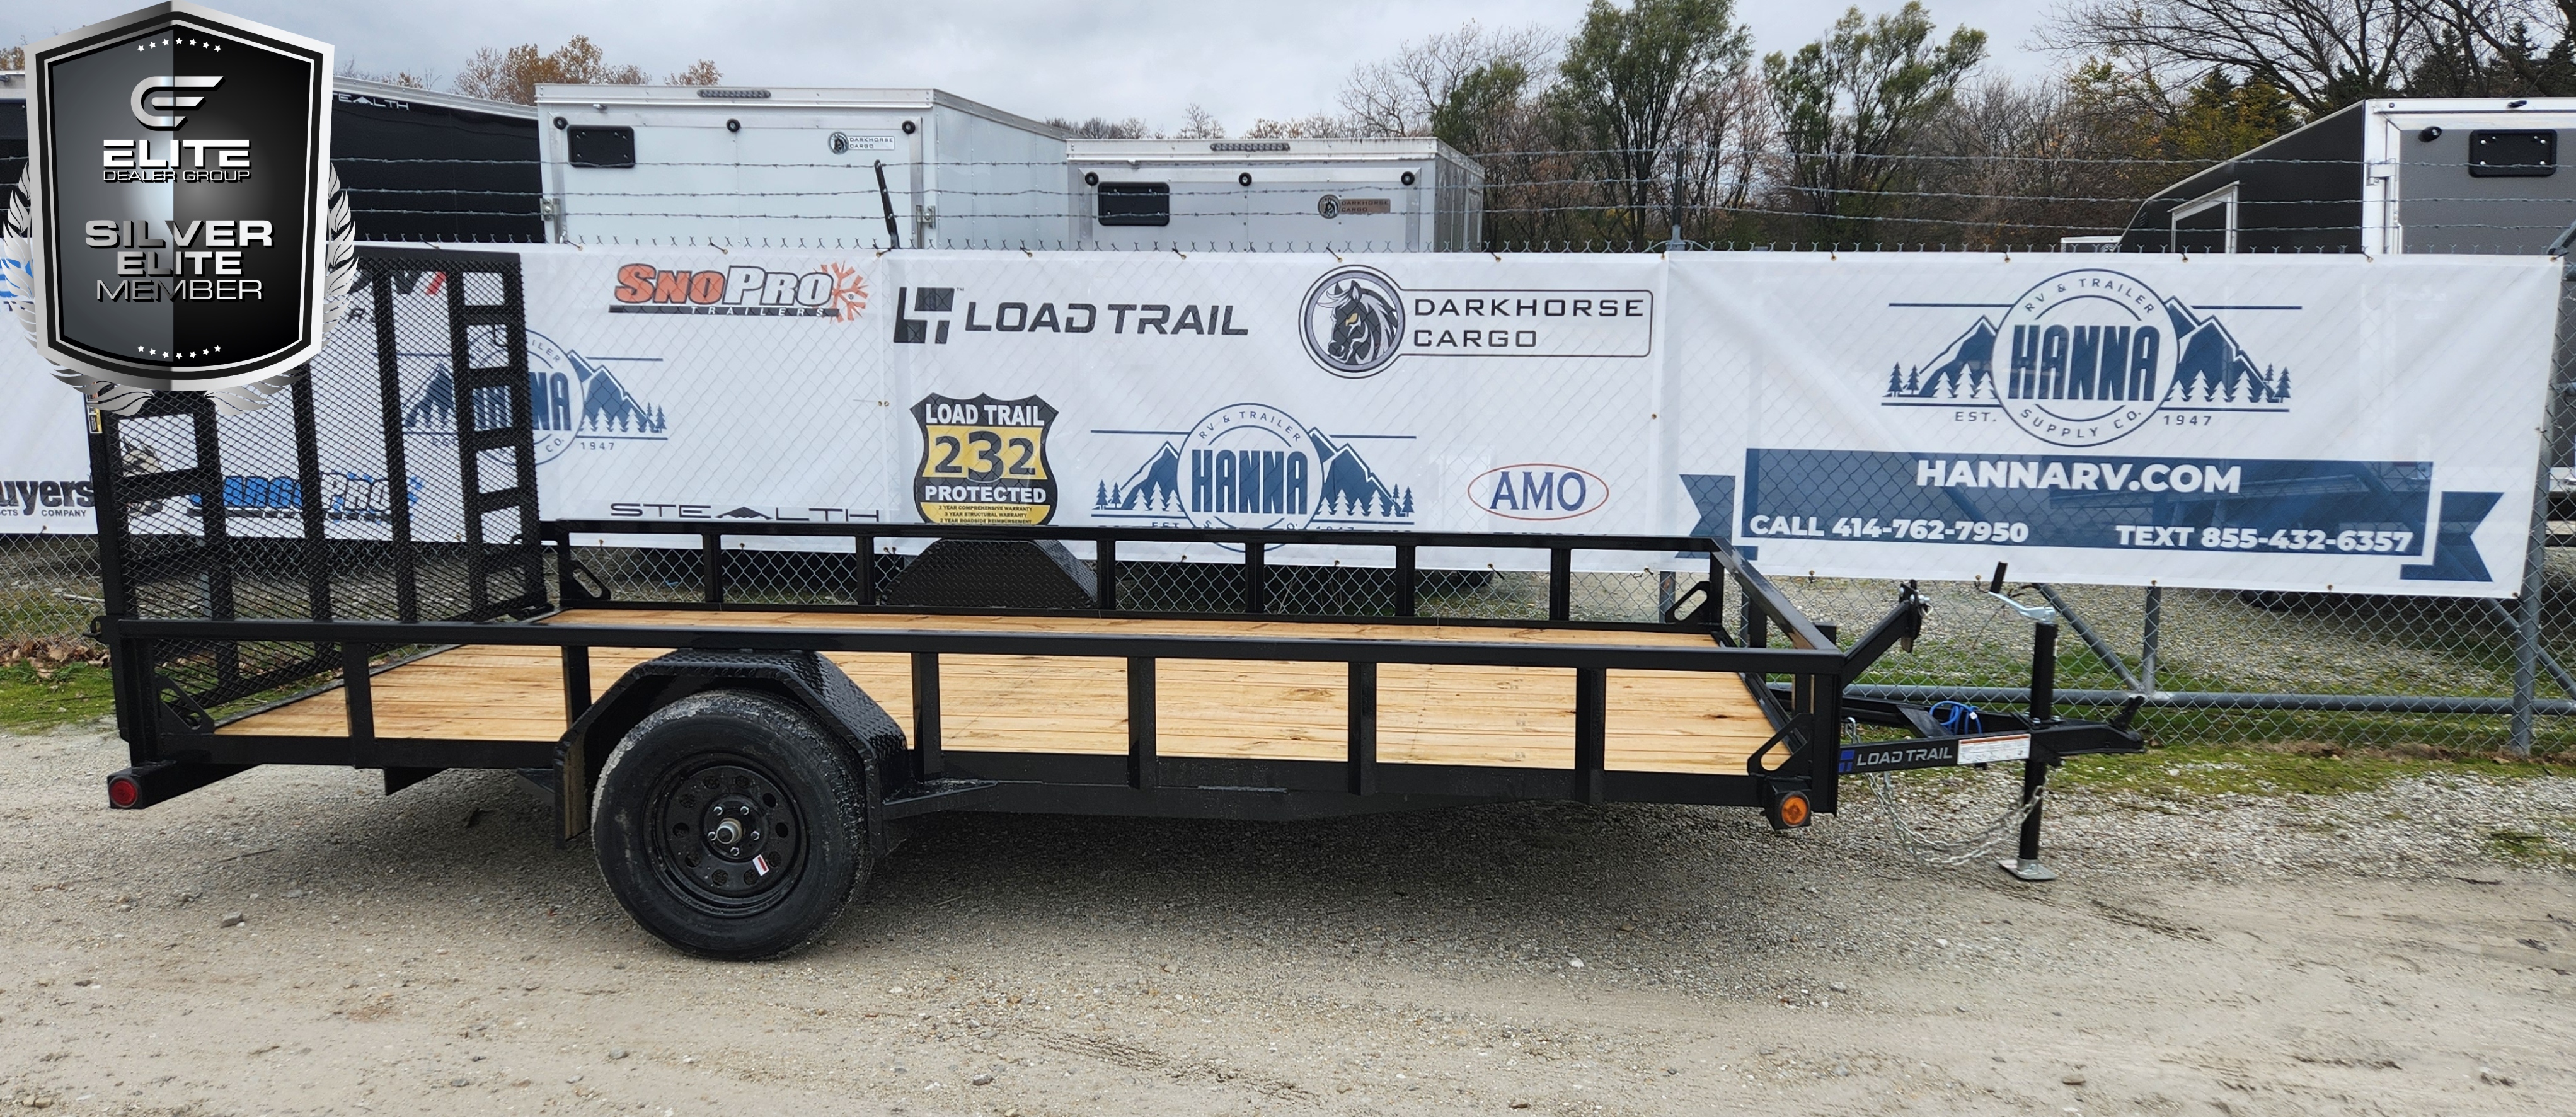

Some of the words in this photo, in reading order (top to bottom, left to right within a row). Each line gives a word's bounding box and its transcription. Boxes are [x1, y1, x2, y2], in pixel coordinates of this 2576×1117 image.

[1414, 299, 1644, 317] DARKHORSE
[2025, 292, 2045, 314] RV
[2057, 284, 2066, 293] &
[2078, 278, 2155, 314] TRAILER
[691, 306, 824, 316] TRAILERS
[965, 302, 1096, 333] LOAD
[1107, 304, 1249, 335] TRAIL
[1413, 329, 1537, 348] CARGO
[2008, 324, 2161, 401] HANNA
[926, 403, 978, 425] LOAD
[983, 404, 1045, 426] TRAIL
[1199, 423, 1214, 439] RV
[1222, 415, 1230, 423] &
[1239, 411, 1301, 442] TRAILER
[1955, 411, 1997, 422] EST.
[2020, 408, 2098, 438] SUPPLY
[2113, 410, 2142, 429] CO.
[2163, 415, 2212, 425] 1947
[580, 442, 615, 451] 1947
[934, 430, 1036, 483] 232
[1192, 449, 1308, 514] HANNA
[1916, 459, 2241, 494] HANNARV.COM
[925, 485, 1047, 503] PROTECTED
[1490, 471, 1587, 512] AMO
[611, 503, 880, 522] STEALTH
[1749, 515, 1824, 536] CALL
[1832, 517, 2029, 542] 414-762-7950
[2115, 525, 2194, 547] TEXT
[2201, 527, 2413, 553] 855-432-6357
[1856, 750, 1903, 766] LOAD
[1906, 747, 1953, 762] TRAIL
